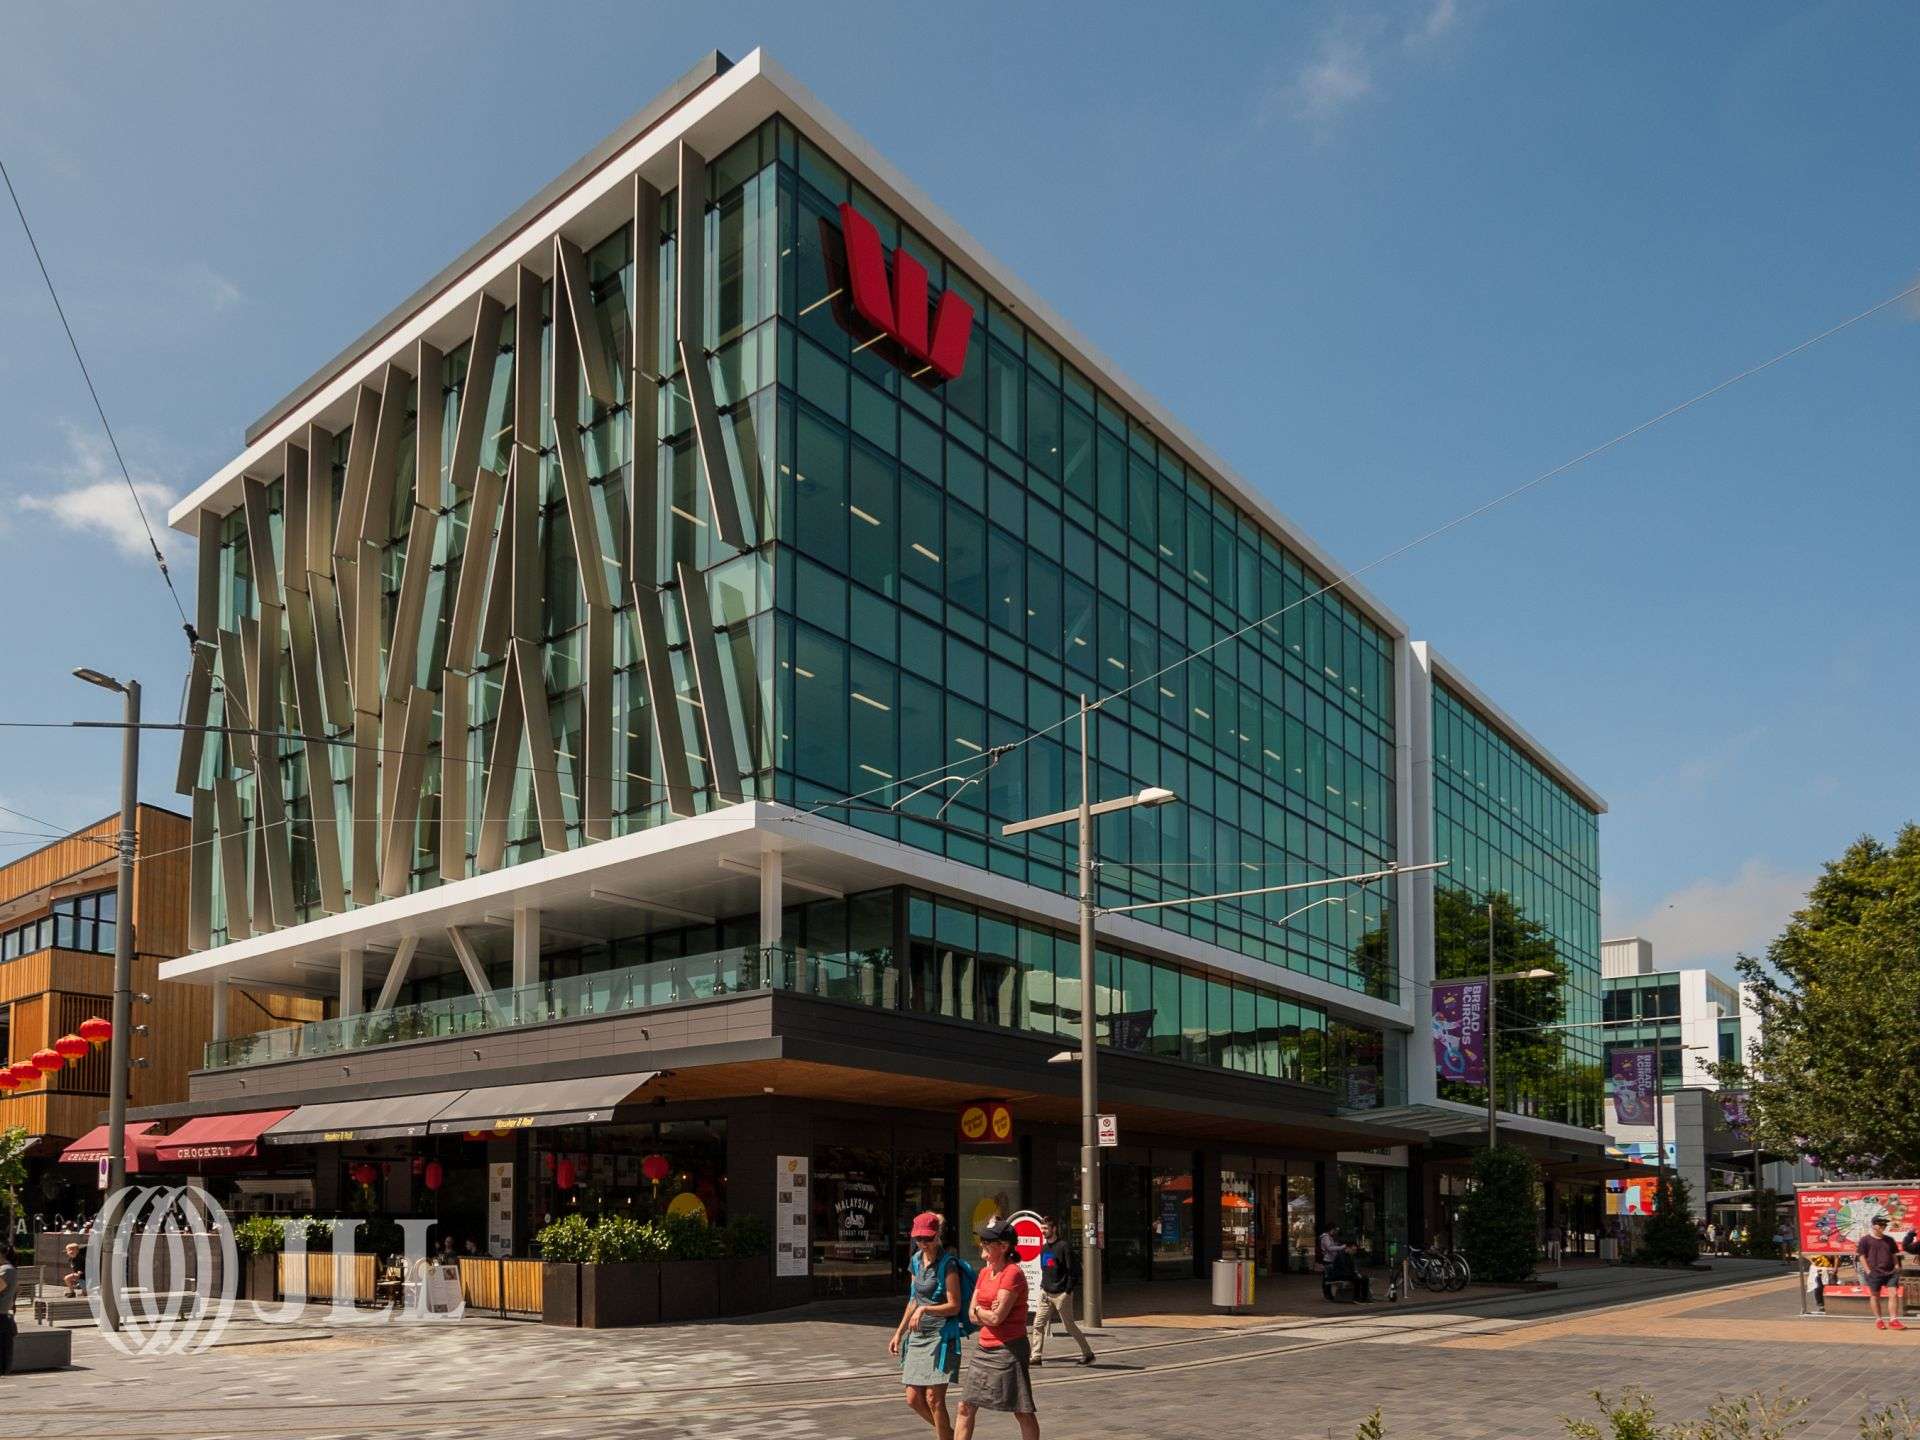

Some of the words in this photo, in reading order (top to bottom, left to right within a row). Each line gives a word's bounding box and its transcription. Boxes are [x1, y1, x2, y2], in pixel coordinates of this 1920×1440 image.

[1471, 985, 1482, 1032] BREAD
[177, 1147, 232, 1159] CROCKETT
[835, 1197, 874, 1214] MALAYSIAN
[1801, 1195, 1835, 1204] Explore
